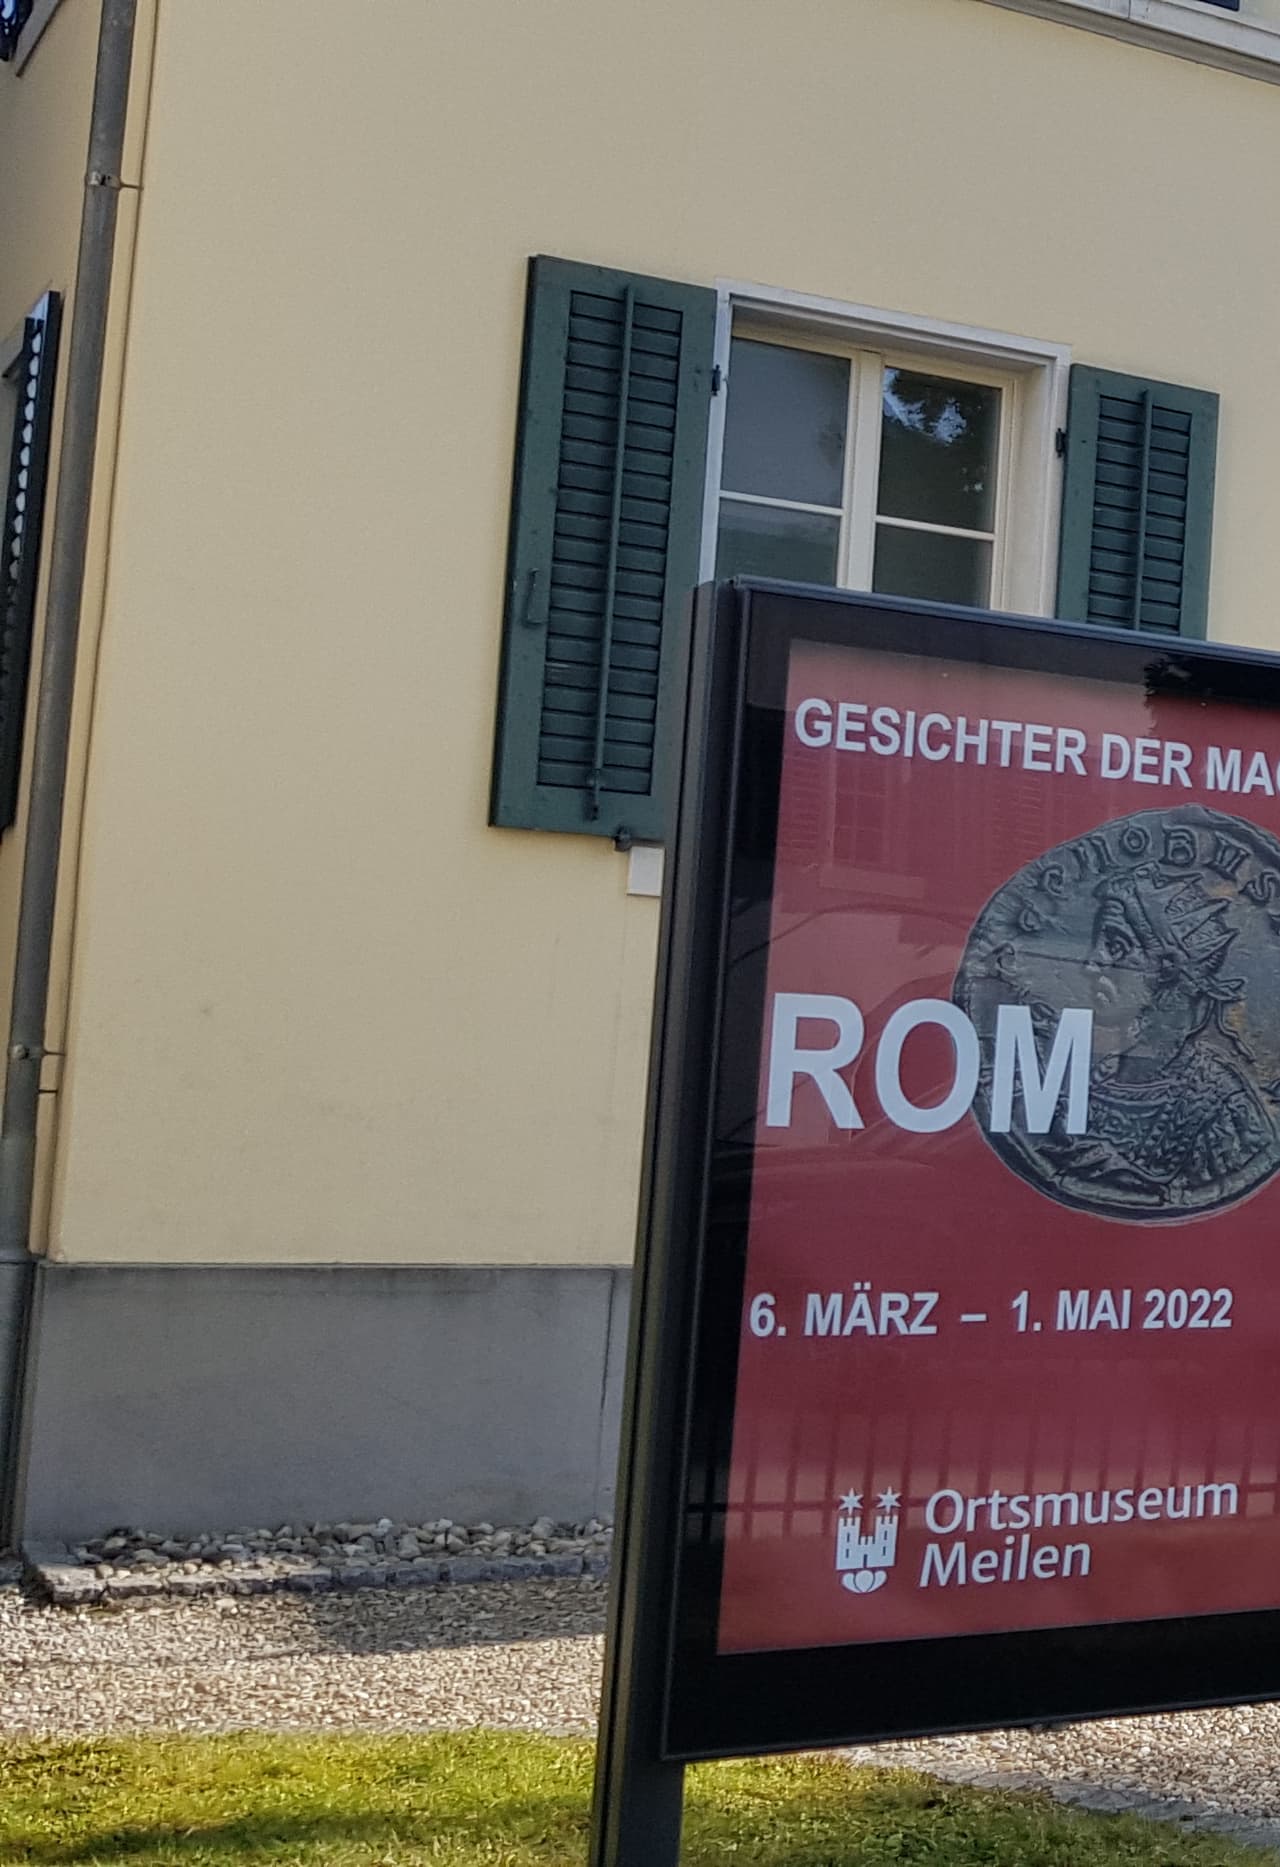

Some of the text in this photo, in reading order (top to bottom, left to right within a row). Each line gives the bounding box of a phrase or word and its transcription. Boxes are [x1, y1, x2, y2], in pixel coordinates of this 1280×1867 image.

[793, 697, 1088, 777] GESICHTER
[1099, 733, 1193, 788] DER
[765, 991, 1094, 1135] ROM
[749, 1293, 787, 1337] 6.
[803, 1281, 939, 1337] MÄRZ
[1010, 1290, 1042, 1332] 1.
[1056, 1288, 1132, 1332] MAI
[1142, 1287, 1234, 1330] 2022
[925, 1482, 1239, 1535] Ortsmuseum
[919, 1533, 1093, 1589] Meilen
